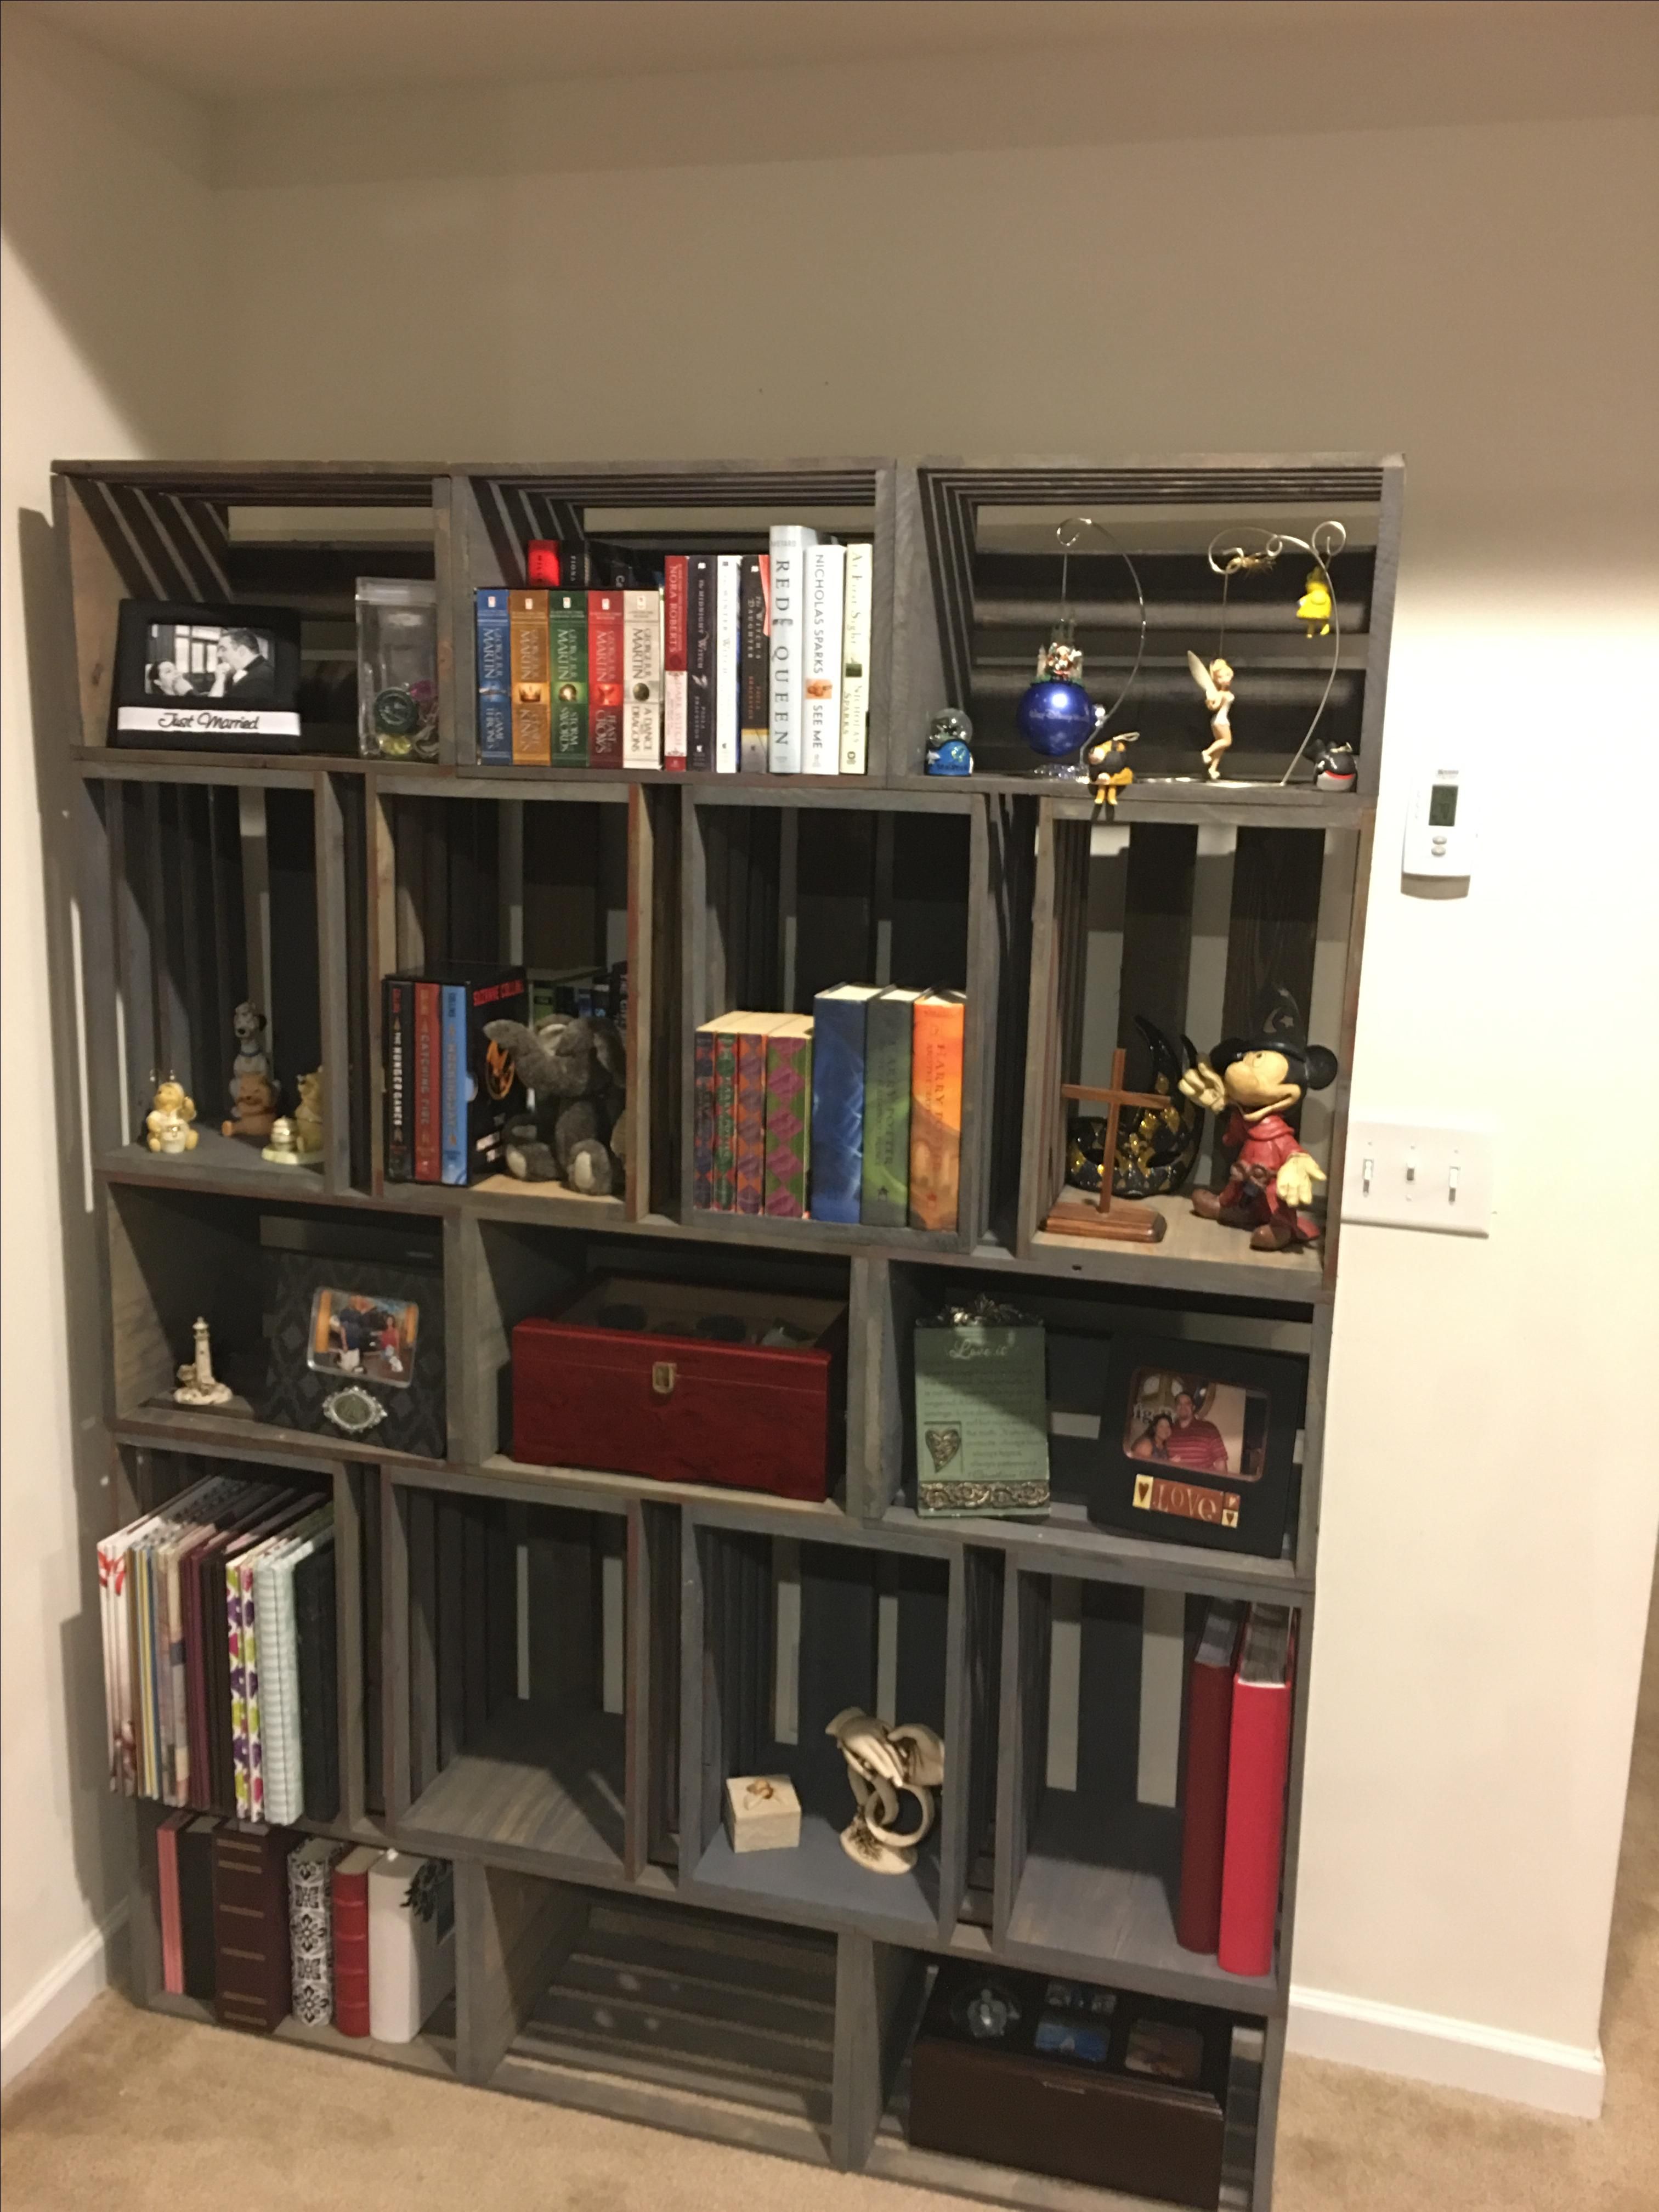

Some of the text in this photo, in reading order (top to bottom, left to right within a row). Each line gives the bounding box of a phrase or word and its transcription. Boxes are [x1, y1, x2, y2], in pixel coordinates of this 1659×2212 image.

[668, 565, 679, 653] NORA ROBERTS
[813, 553, 825, 674] NICHOLAS SPARKS
[483, 629, 495, 679] MARTIN
[520, 630, 531, 681] MARTIN
[557, 629, 569, 680] MARTIN
[596, 630, 608, 682] MARTIN
[632, 628, 644, 680] MARTIN
[772, 559, 791, 746] RED QUEEN
[158, 712, 261, 729] Just Married
[675, 682, 683, 709] DARK
[843, 691, 853, 736] SPARKS
[813, 705, 823, 749] SEE ME
[393, 1046, 403, 1090] HUNGER
[421, 1034, 431, 1093] CATCHING
[935, 1043, 946, 1105] HARRY
[393, 1091, 403, 1126] GAMES
